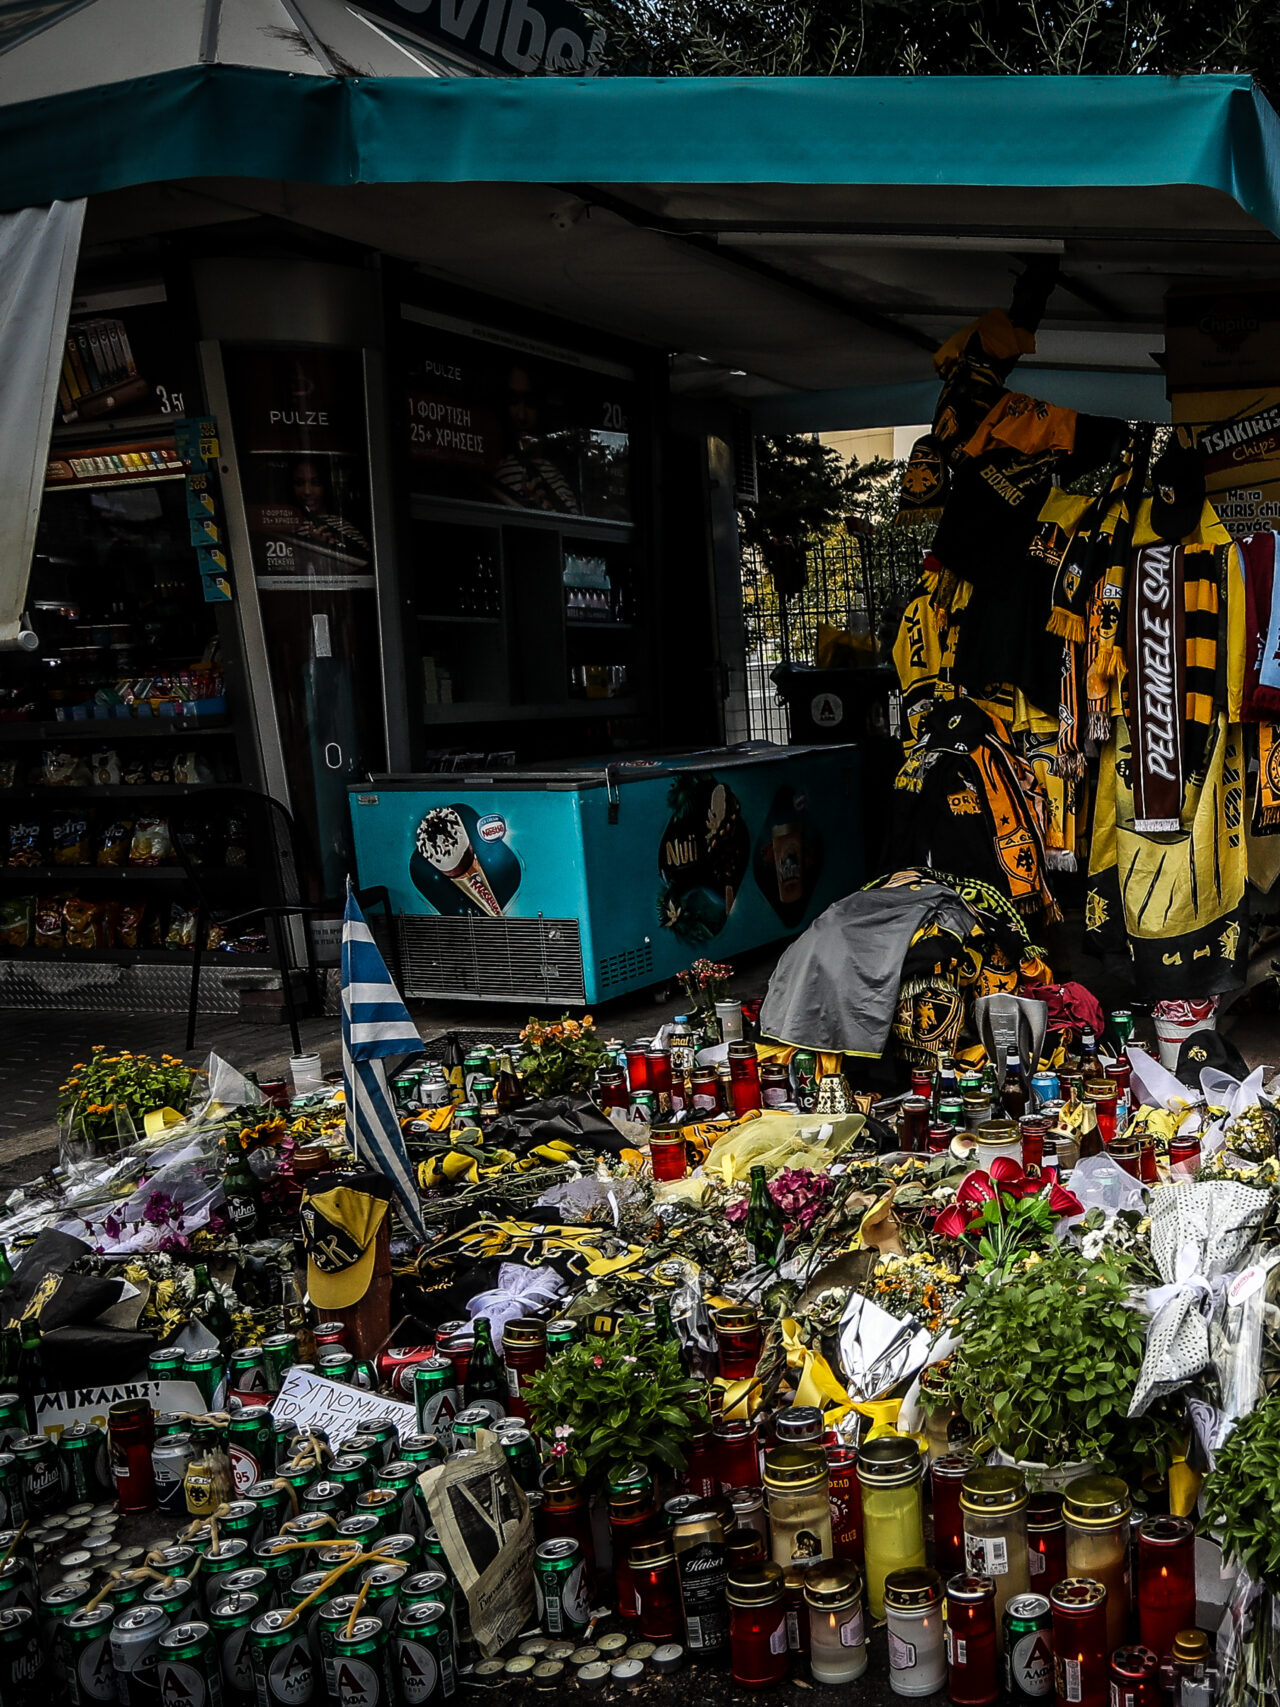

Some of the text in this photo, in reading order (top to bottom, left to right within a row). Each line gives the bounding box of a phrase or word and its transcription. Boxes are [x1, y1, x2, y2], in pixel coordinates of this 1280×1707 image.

[425, 360, 463, 382] PULZE
[270, 410, 330, 427] PULZE
[417, 401, 472, 429] ΦΟΡΤΙΣΗ
[444, 428, 488, 454] ΧΡΗΣΕΙΣ
[1232, 437, 1277, 461] Chips
[265, 540, 294, 558] 20€
[37, 1381, 161, 1414] ΜΙΧΑΛΗΣ!
[272, 1398, 305, 1421] ΠΟΥ
